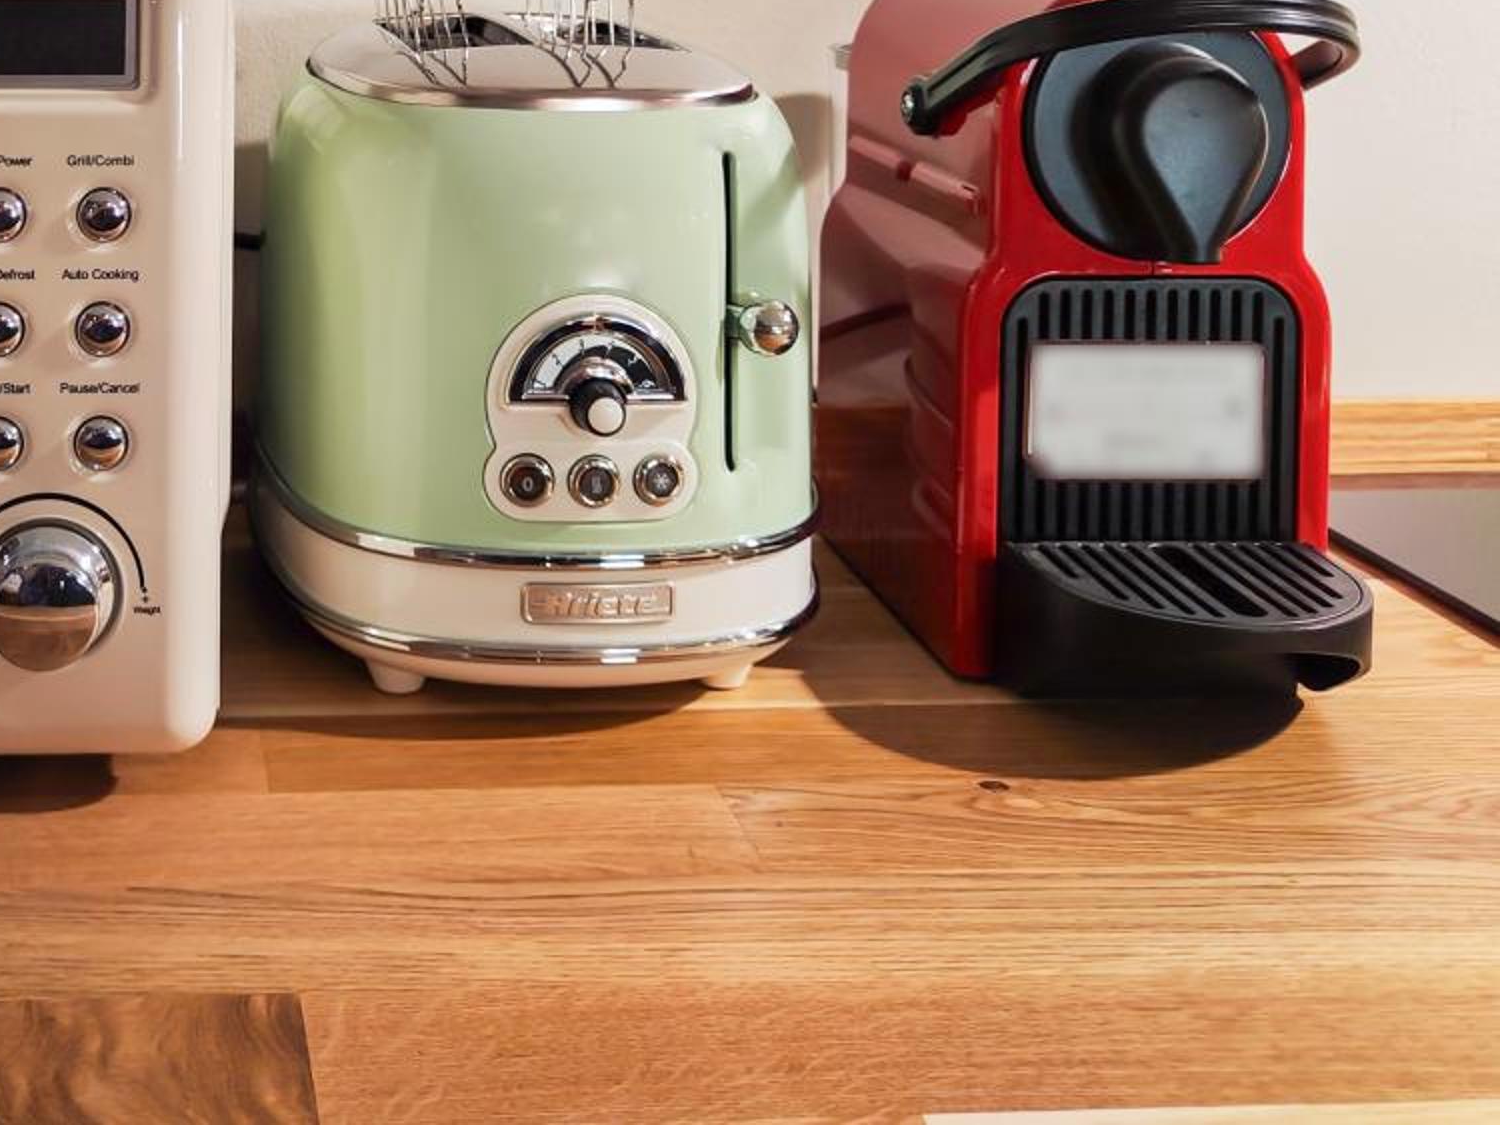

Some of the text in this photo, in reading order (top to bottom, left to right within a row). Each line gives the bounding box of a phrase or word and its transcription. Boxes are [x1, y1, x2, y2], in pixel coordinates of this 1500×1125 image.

[66, 154, 135, 167] Grill/Combi
[61, 268, 139, 282] Auto Cooking
[59, 381, 140, 394] Pause/Cancel
